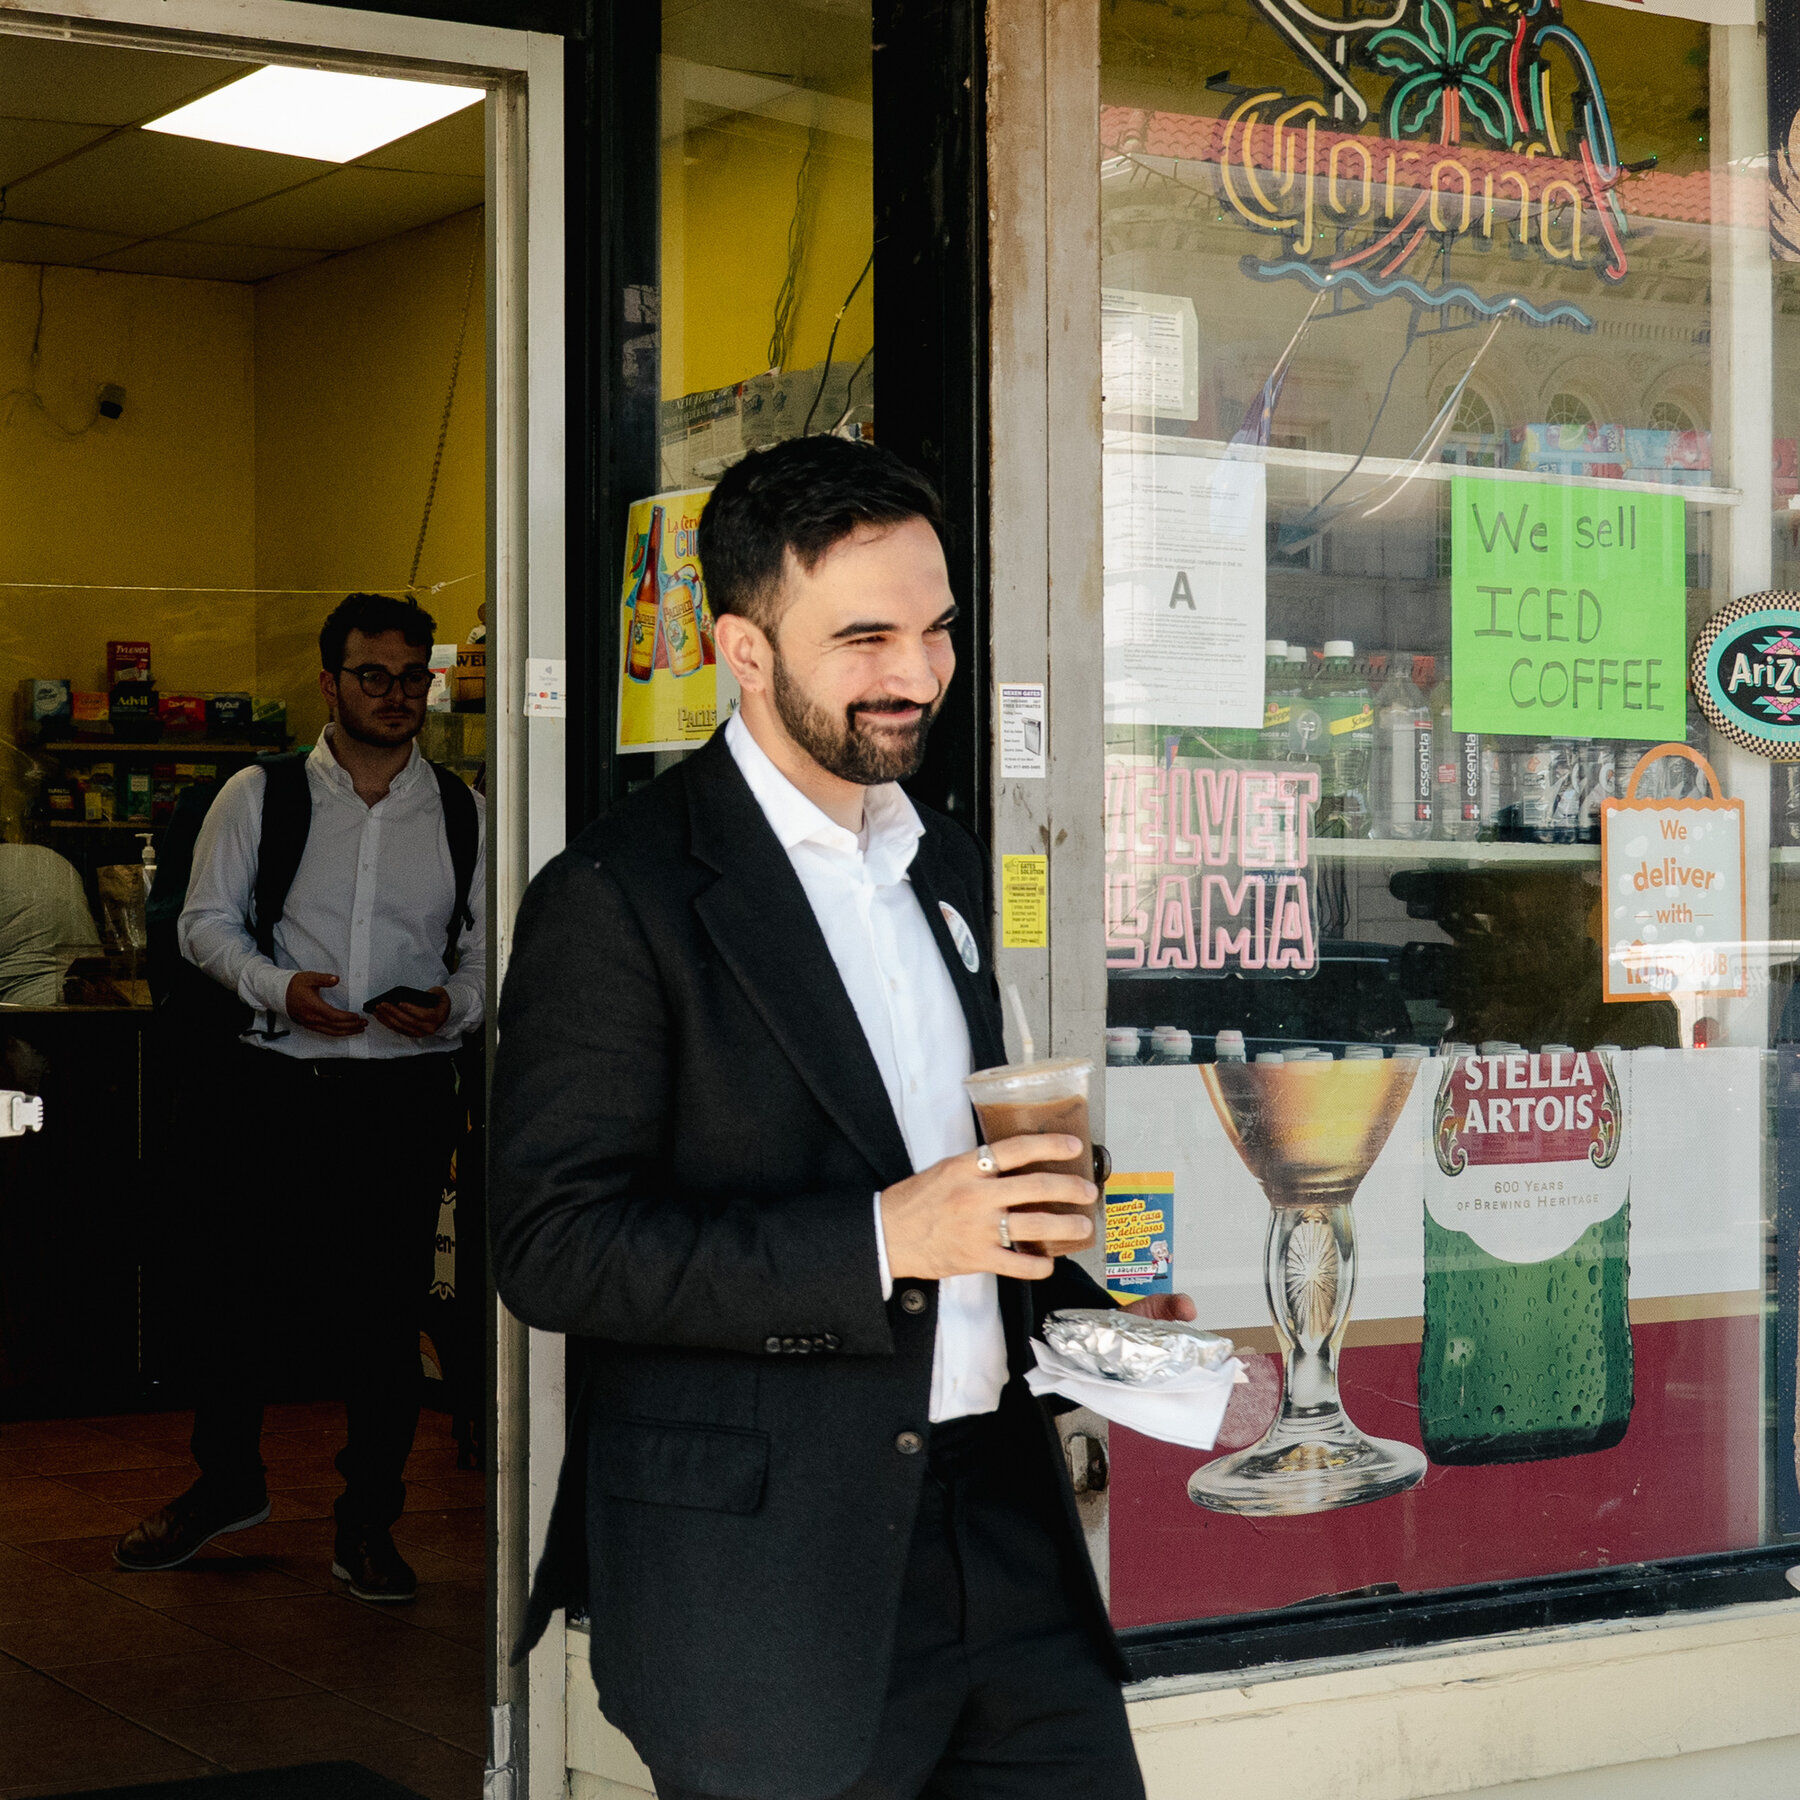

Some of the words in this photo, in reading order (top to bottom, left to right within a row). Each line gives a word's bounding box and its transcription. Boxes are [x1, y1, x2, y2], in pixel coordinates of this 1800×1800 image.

[1220, 92, 1584, 262] Corona
[681, 514, 701, 532] Cerv
[1471, 502, 1549, 555] We
[1574, 505, 1637, 550] sell
[1169, 571, 1197, 611] A
[1472, 584, 1602, 643] ICED
[1509, 657, 1665, 712] COFFEE
[119, 695, 148, 706] Advil
[1660, 819, 1687, 841] We
[1633, 857, 1716, 892] deliver
[1656, 903, 1693, 924] with
[1464, 1052, 1594, 1091] STELLA
[1462, 1095, 1595, 1134] ARTOIS
[1494, 1181, 1519, 1194] 600
[1106, 1200, 1143, 1214] ecuerda
[1131, 1215, 1138, 1223] a
[1140, 1211, 1162, 1222] casa
[1118, 1224, 1163, 1237] deliciosos
[1121, 1250, 1133, 1260] de
